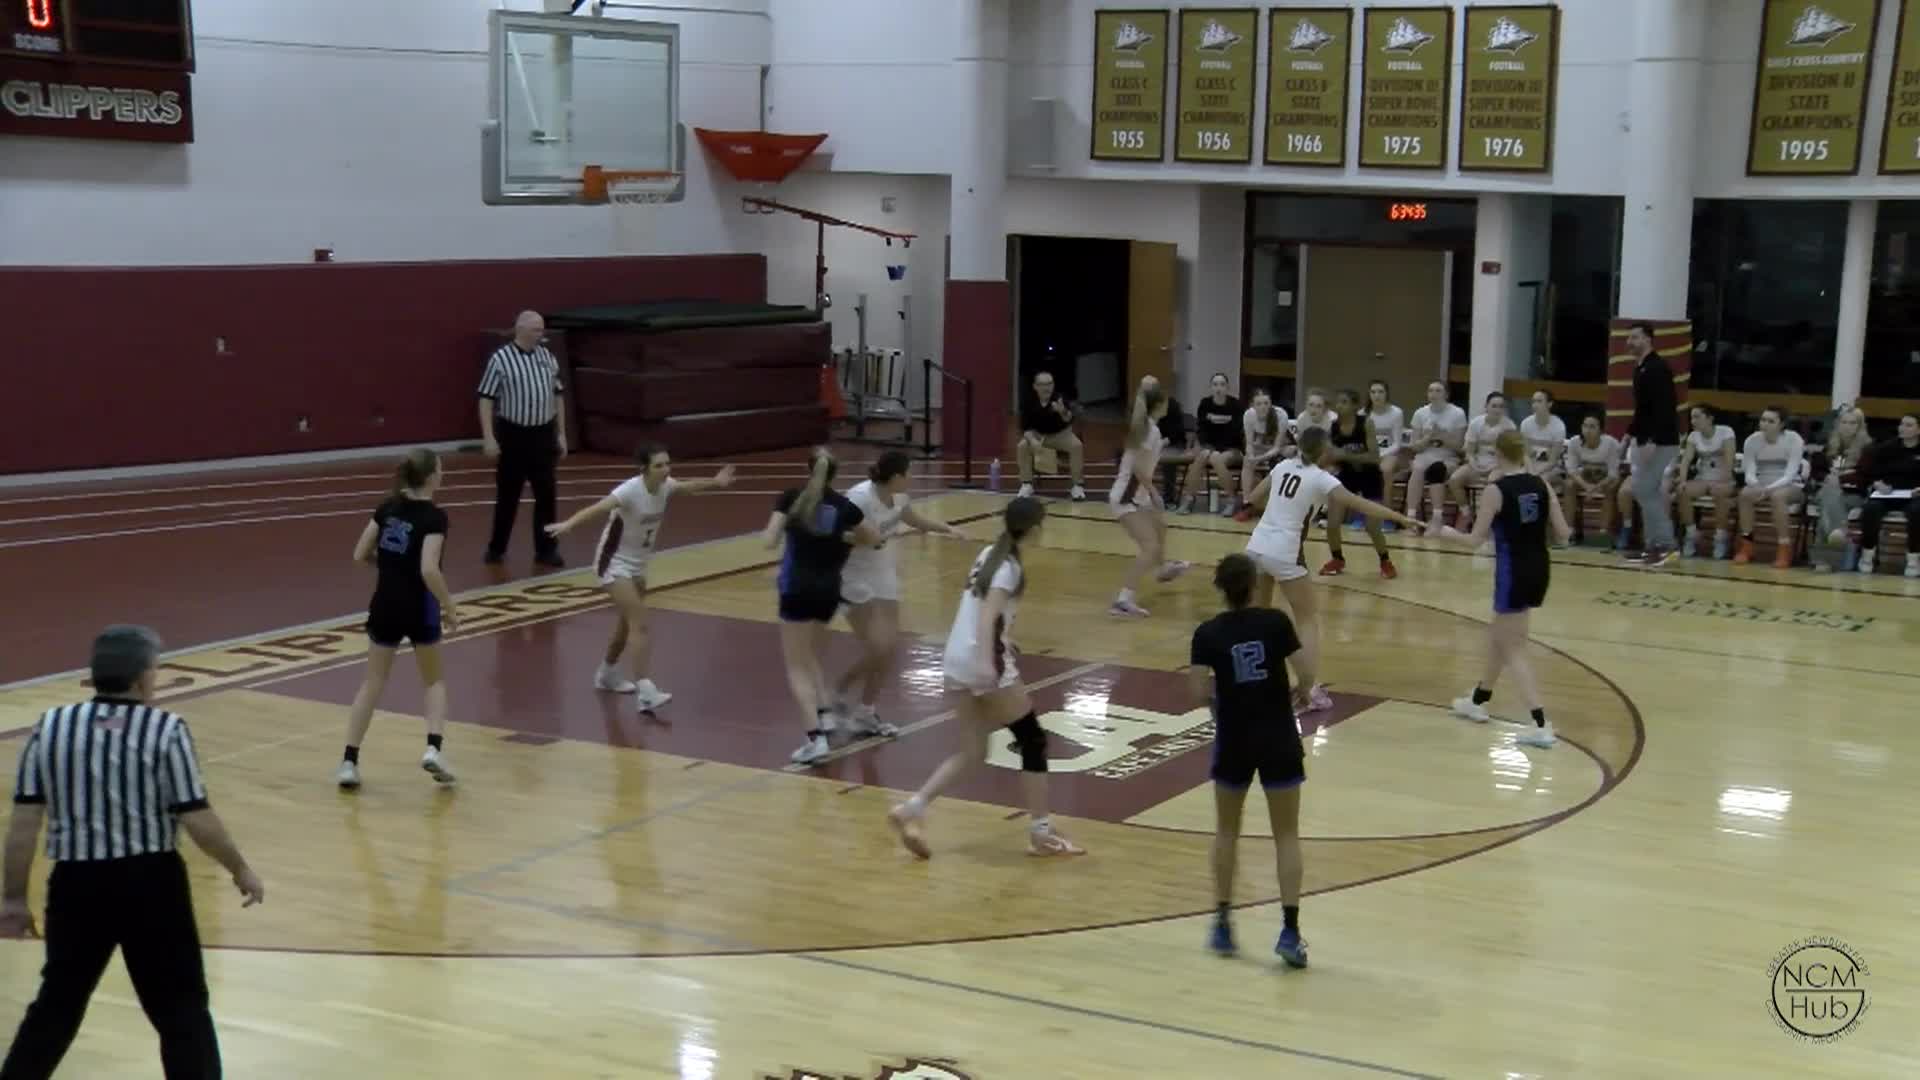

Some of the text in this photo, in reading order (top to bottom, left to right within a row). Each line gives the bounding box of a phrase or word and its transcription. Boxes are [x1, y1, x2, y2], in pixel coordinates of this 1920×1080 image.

[1195, 78, 1226, 91] CLASS
[1286, 79, 1318, 92] CLASS
[1767, 73, 1840, 91] DIVISION
[1, 80, 183, 125] CLIPPERS
[1789, 95, 1830, 111] STATE
[1368, 114, 1438, 129] CHAMPIONS
[1470, 115, 1542, 130] CHAMPIONS
[1761, 116, 1854, 131] CHAMPIONS
[1112, 131, 1145, 149] 1955
[1197, 132, 1231, 151] 1956
[1287, 134, 1323, 153] 1966
[1383, 136, 1421, 155] 1975
[1484, 137, 1524, 157] 1976
[1780, 140, 1829, 161] 1995
[1278, 472, 1303, 499] 10
[1231, 639, 1269, 683] 12
